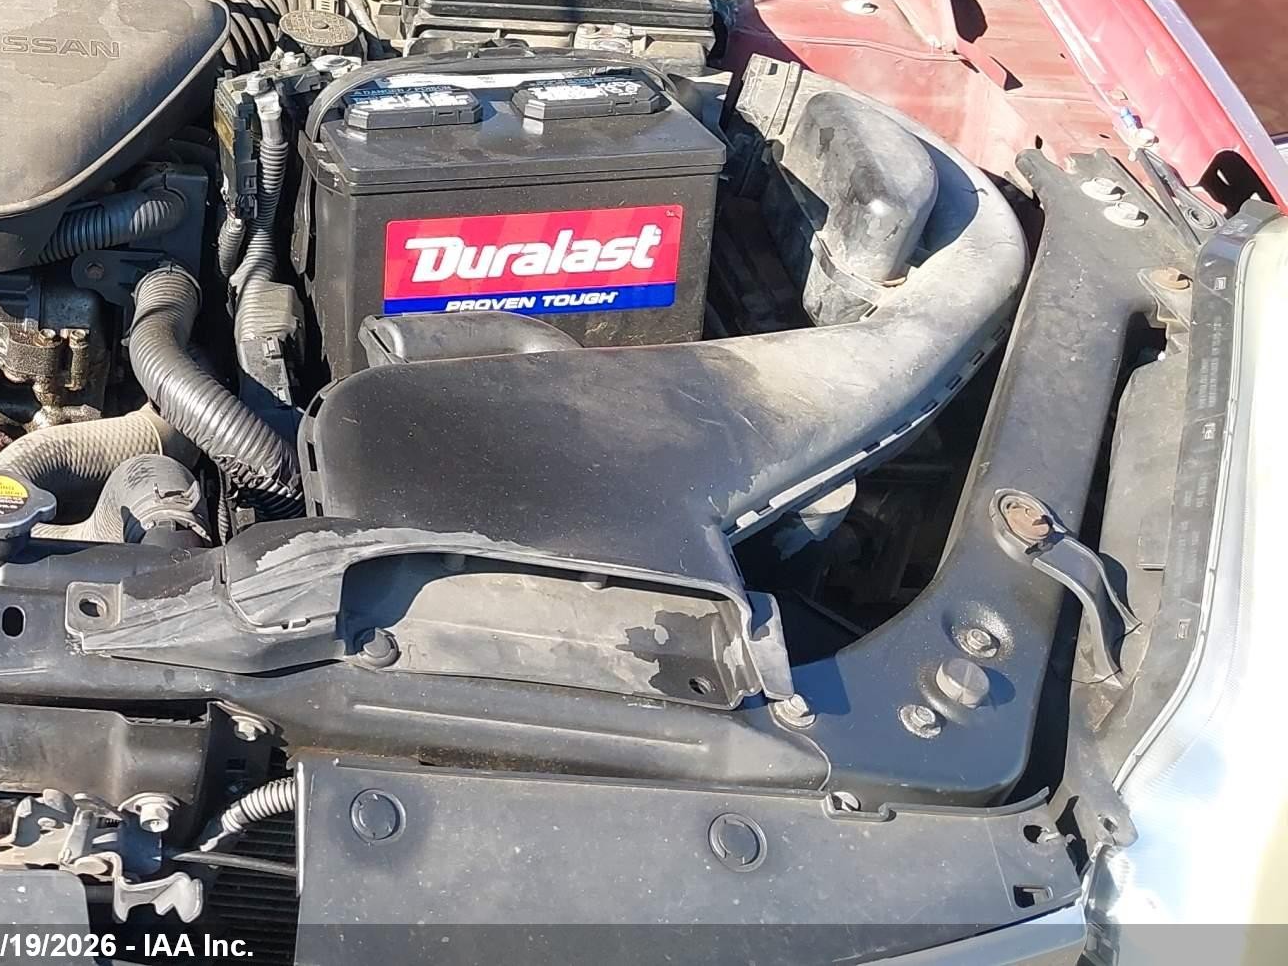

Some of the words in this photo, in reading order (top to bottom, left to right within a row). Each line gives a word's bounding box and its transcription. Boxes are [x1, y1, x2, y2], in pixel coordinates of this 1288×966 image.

[404, 224, 661, 283] Duralast
[445, 296, 536, 312] PROVEN
[543, 291, 617, 308] TOUGH
